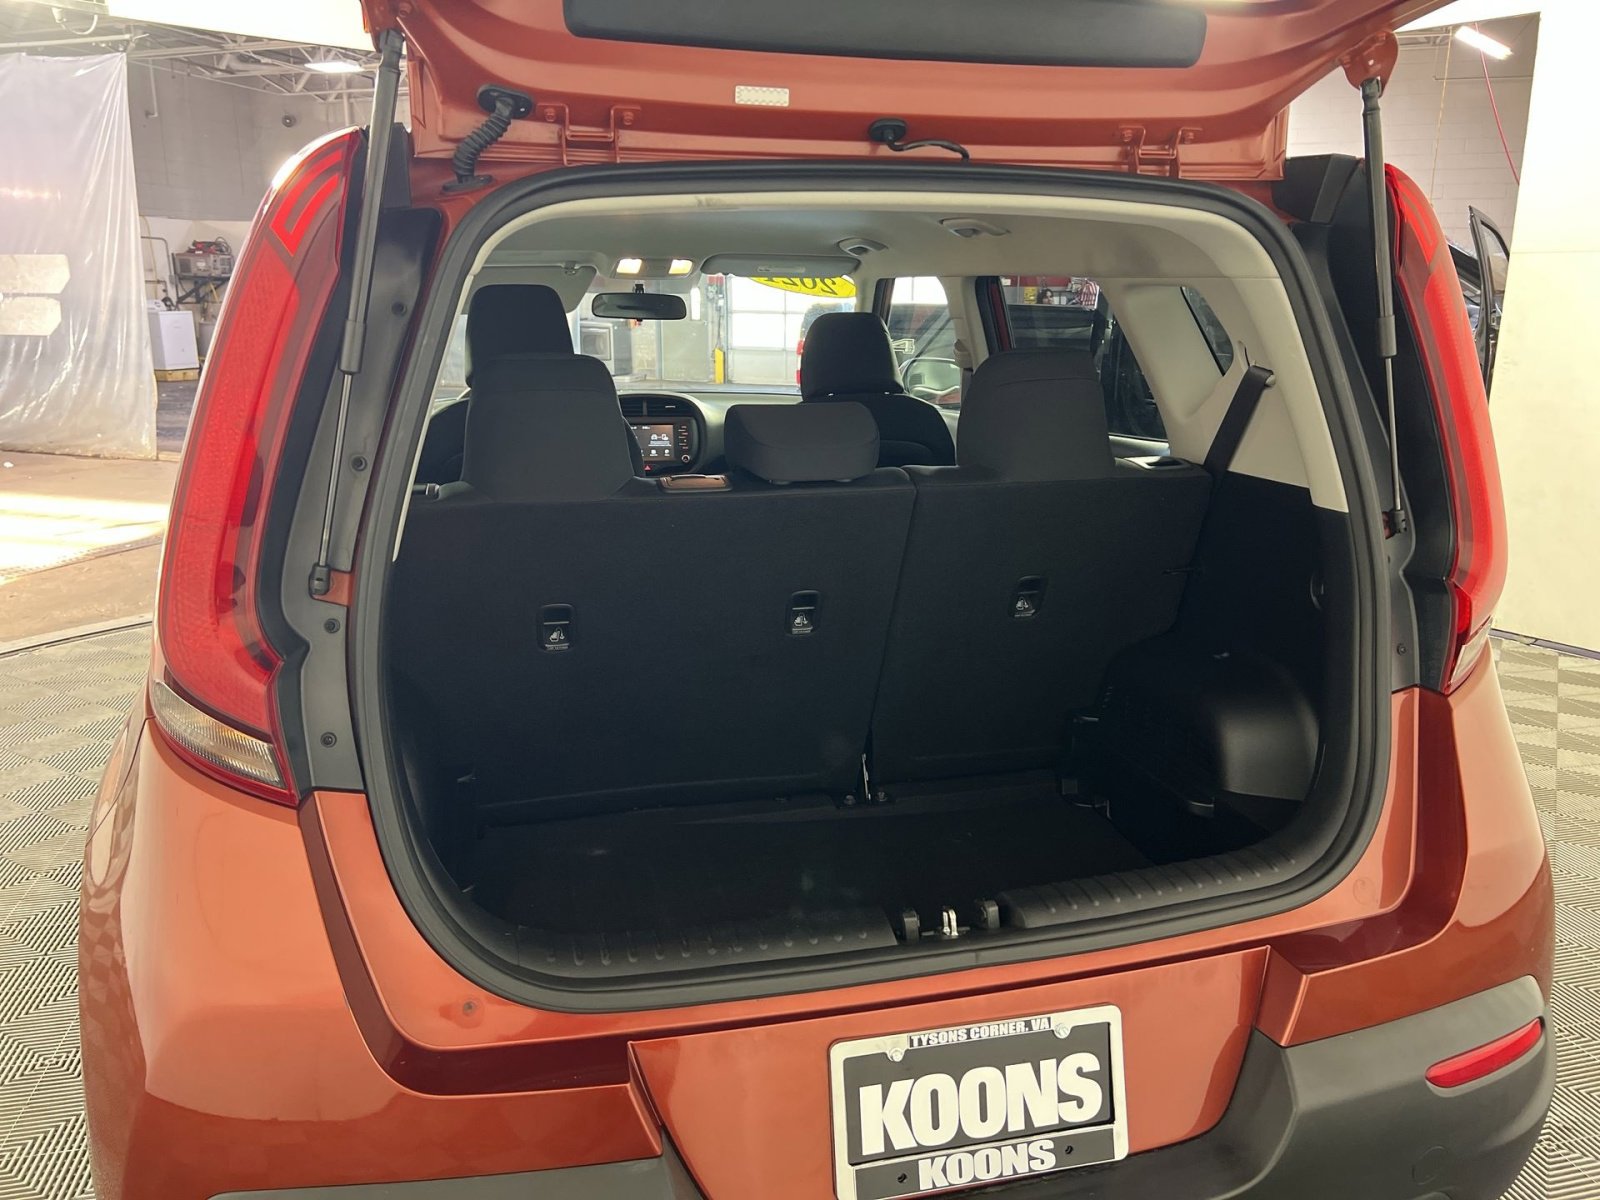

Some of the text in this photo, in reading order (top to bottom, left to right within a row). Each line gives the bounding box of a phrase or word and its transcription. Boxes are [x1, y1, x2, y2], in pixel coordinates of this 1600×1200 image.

[911, 1029, 967, 1047] TYSONS
[1030, 1017, 1050, 1031] VA
[859, 1052, 1102, 1156] KOONS
[918, 1140, 1056, 1191] KOONS
